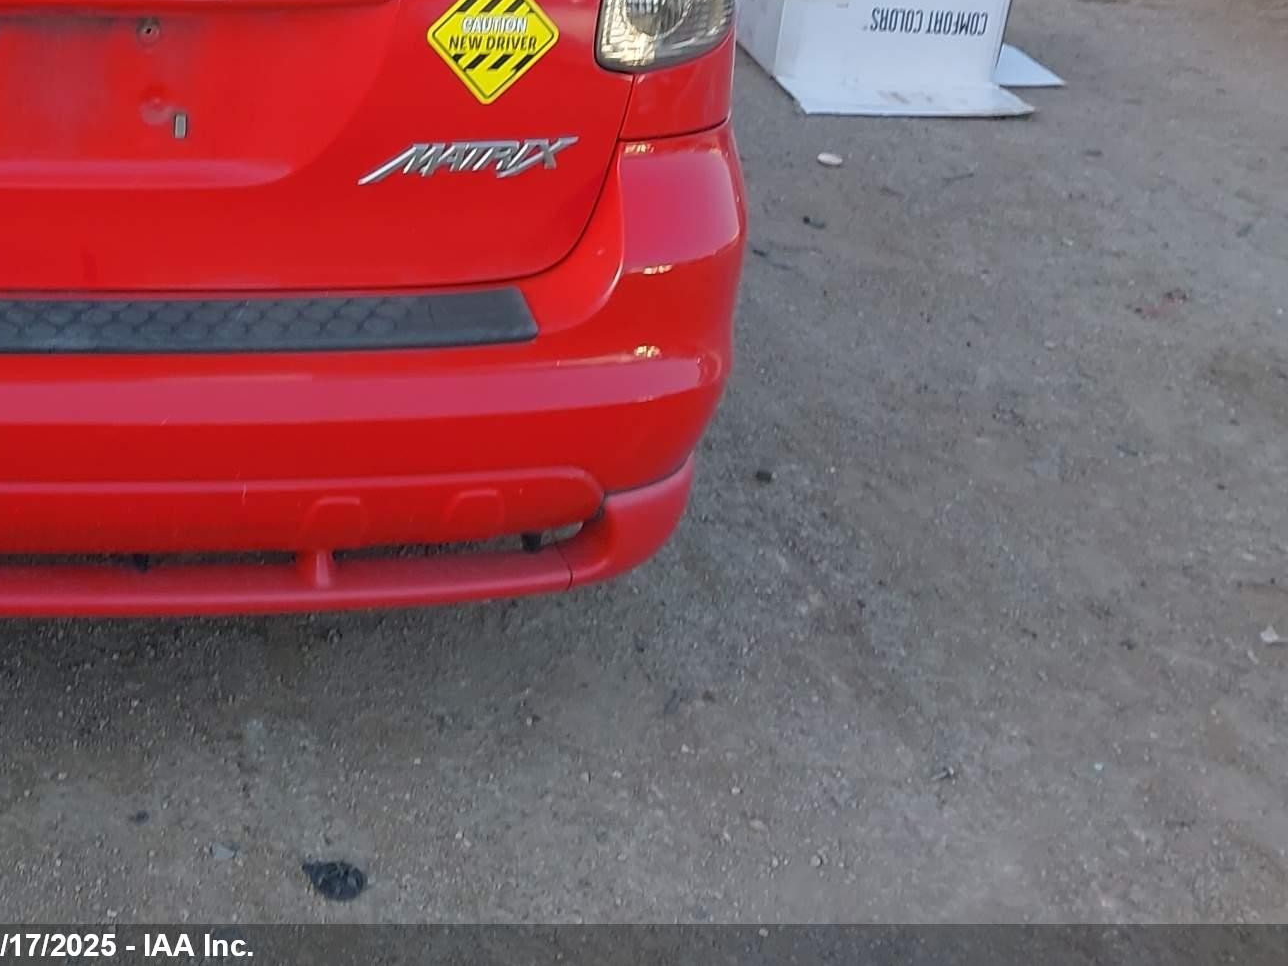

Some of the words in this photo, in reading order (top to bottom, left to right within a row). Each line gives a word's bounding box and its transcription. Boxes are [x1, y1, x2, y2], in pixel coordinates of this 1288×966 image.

[462, 16, 528, 34] CAUTION
[870, 7, 924, 33] COLORS
[925, 10, 989, 36] COMFORT
[449, 35, 483, 52] NEW
[485, 35, 537, 52] DRIVER
[358, 136, 579, 185] MATRIX
